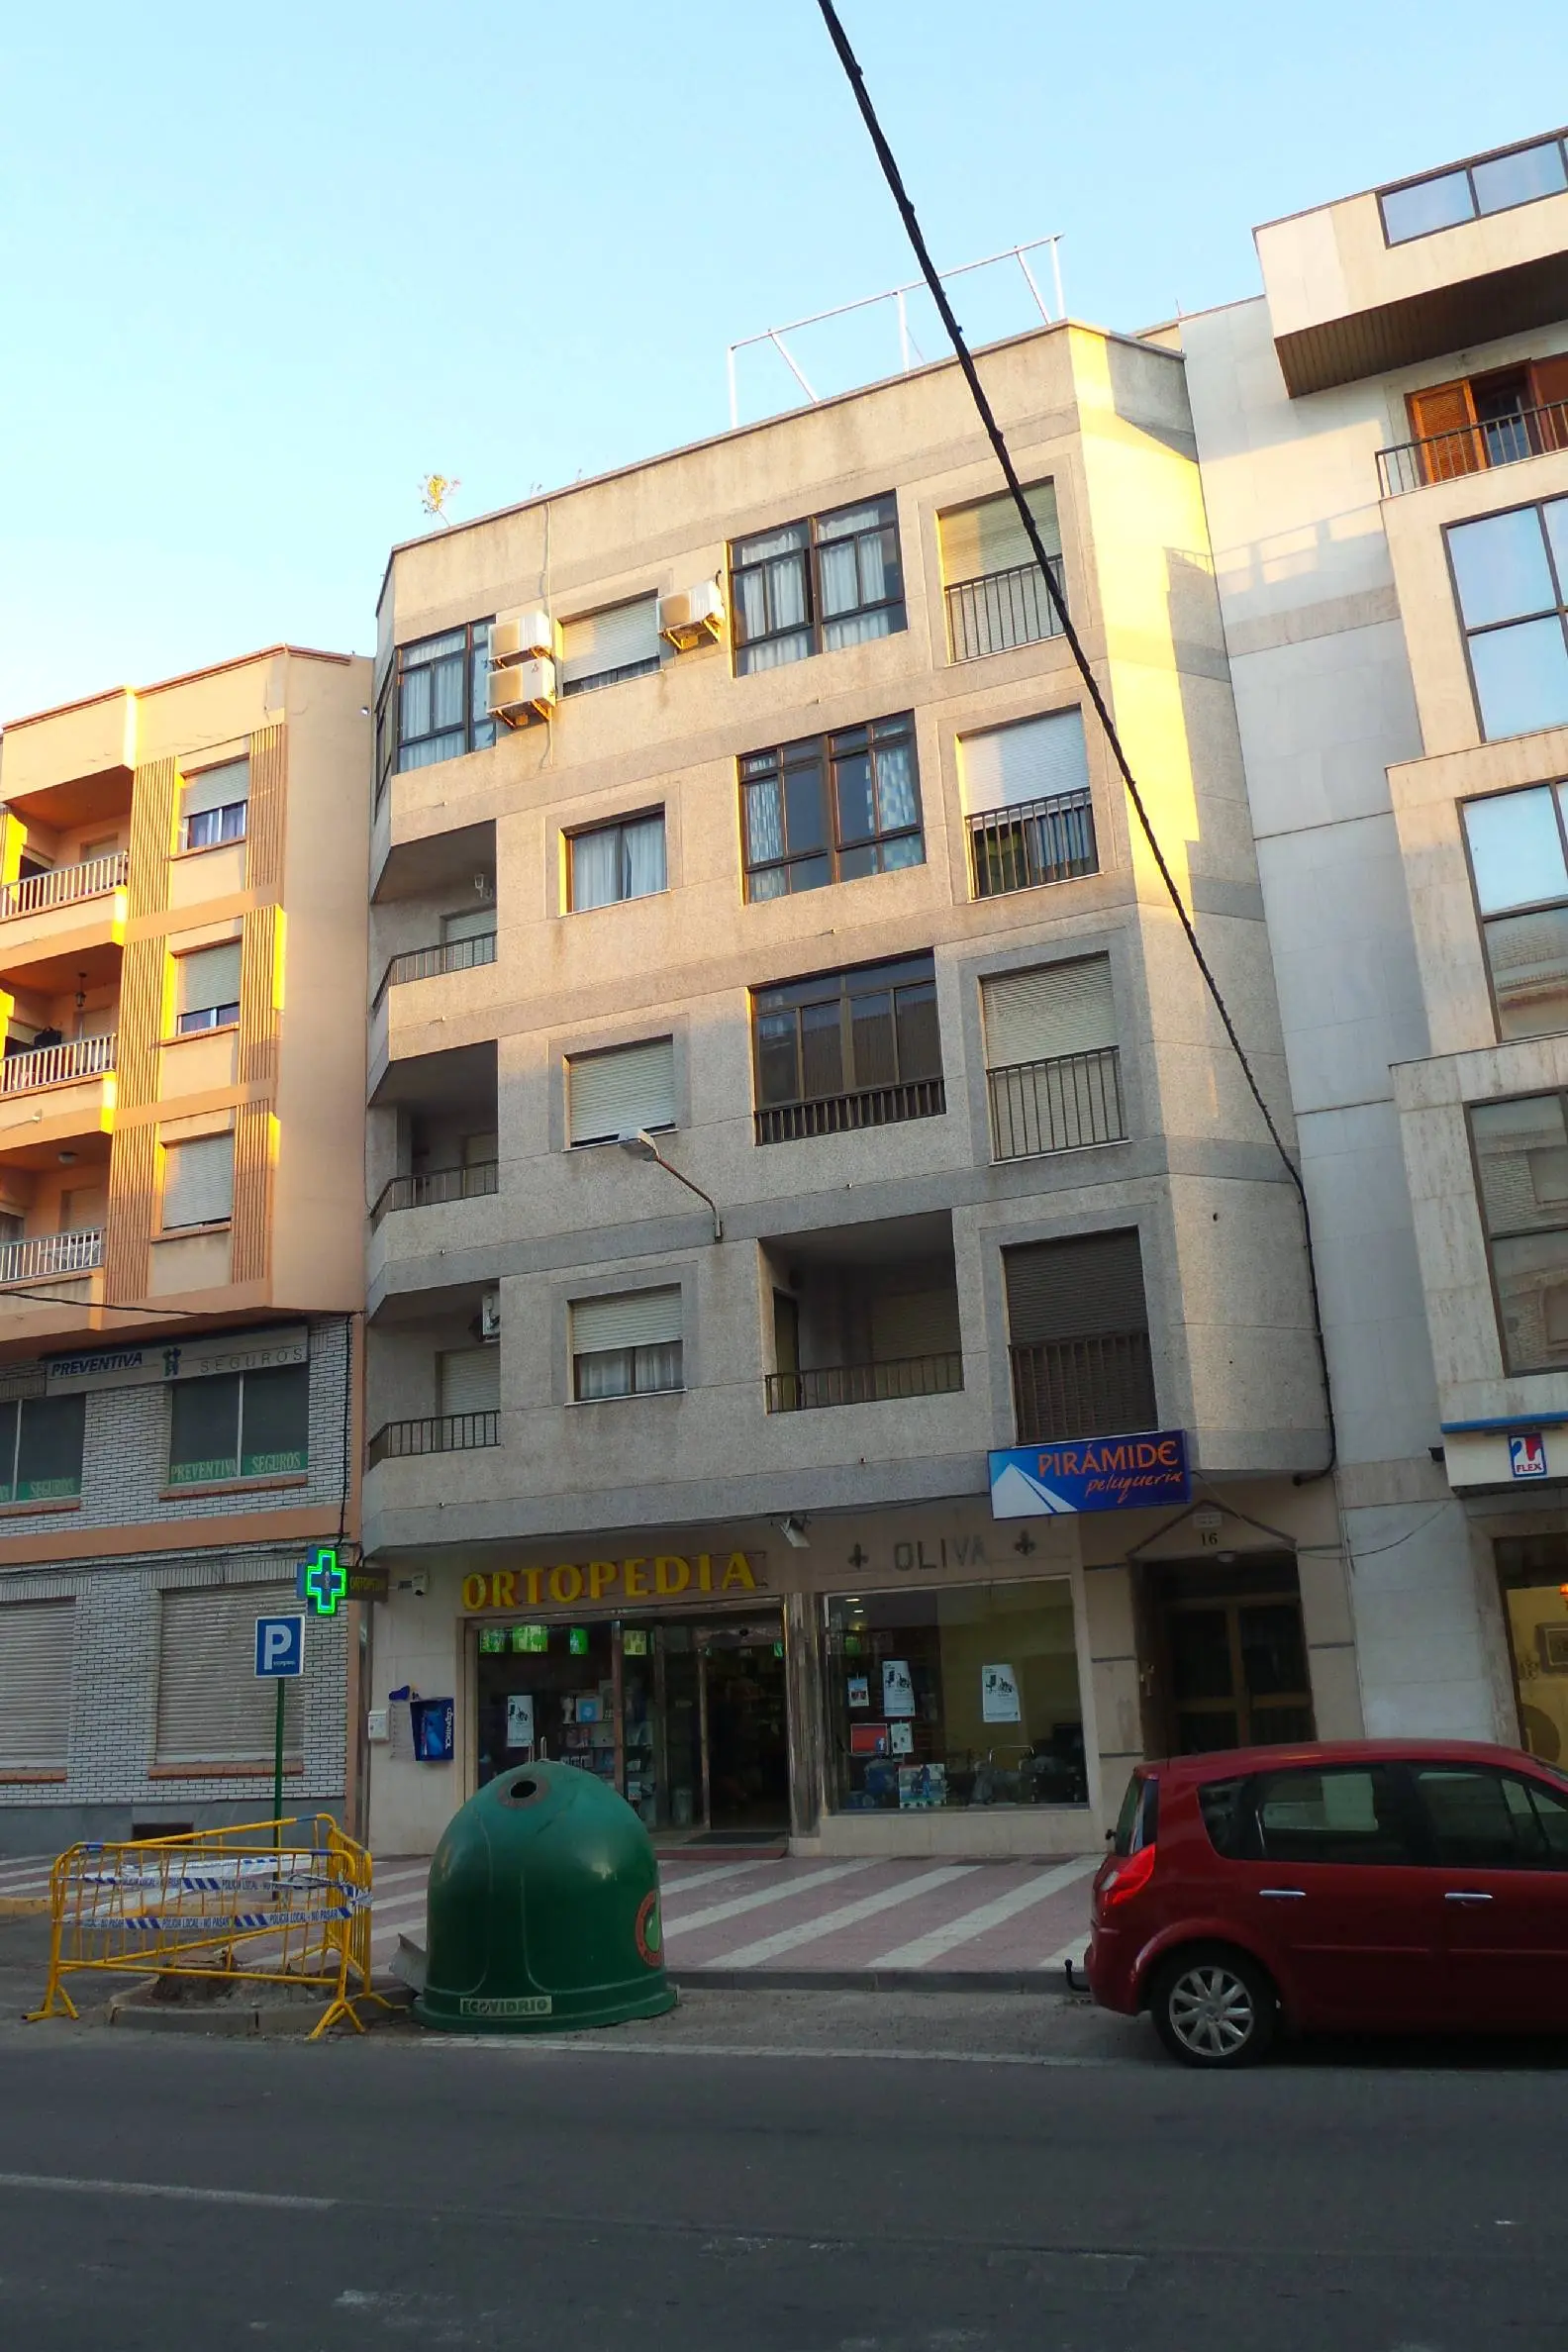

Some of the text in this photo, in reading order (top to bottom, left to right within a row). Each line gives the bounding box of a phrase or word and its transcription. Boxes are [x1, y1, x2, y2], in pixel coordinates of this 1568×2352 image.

[51, 1347, 303, 1377] PREVENTIVA SEGUROS
[251, 1452, 301, 1474] SEGUROS
[1037, 1440, 1178, 1478] PIRÁMIDE
[1516, 1464, 1542, 1473] FLEX
[894, 1535, 987, 1571] OLIVA
[1201, 1532, 1218, 1546] 16
[462, 1552, 756, 1611] ORTOPEDIA
[263, 1624, 292, 1671] P
[462, 1997, 547, 2013] ECOVIDRIO
